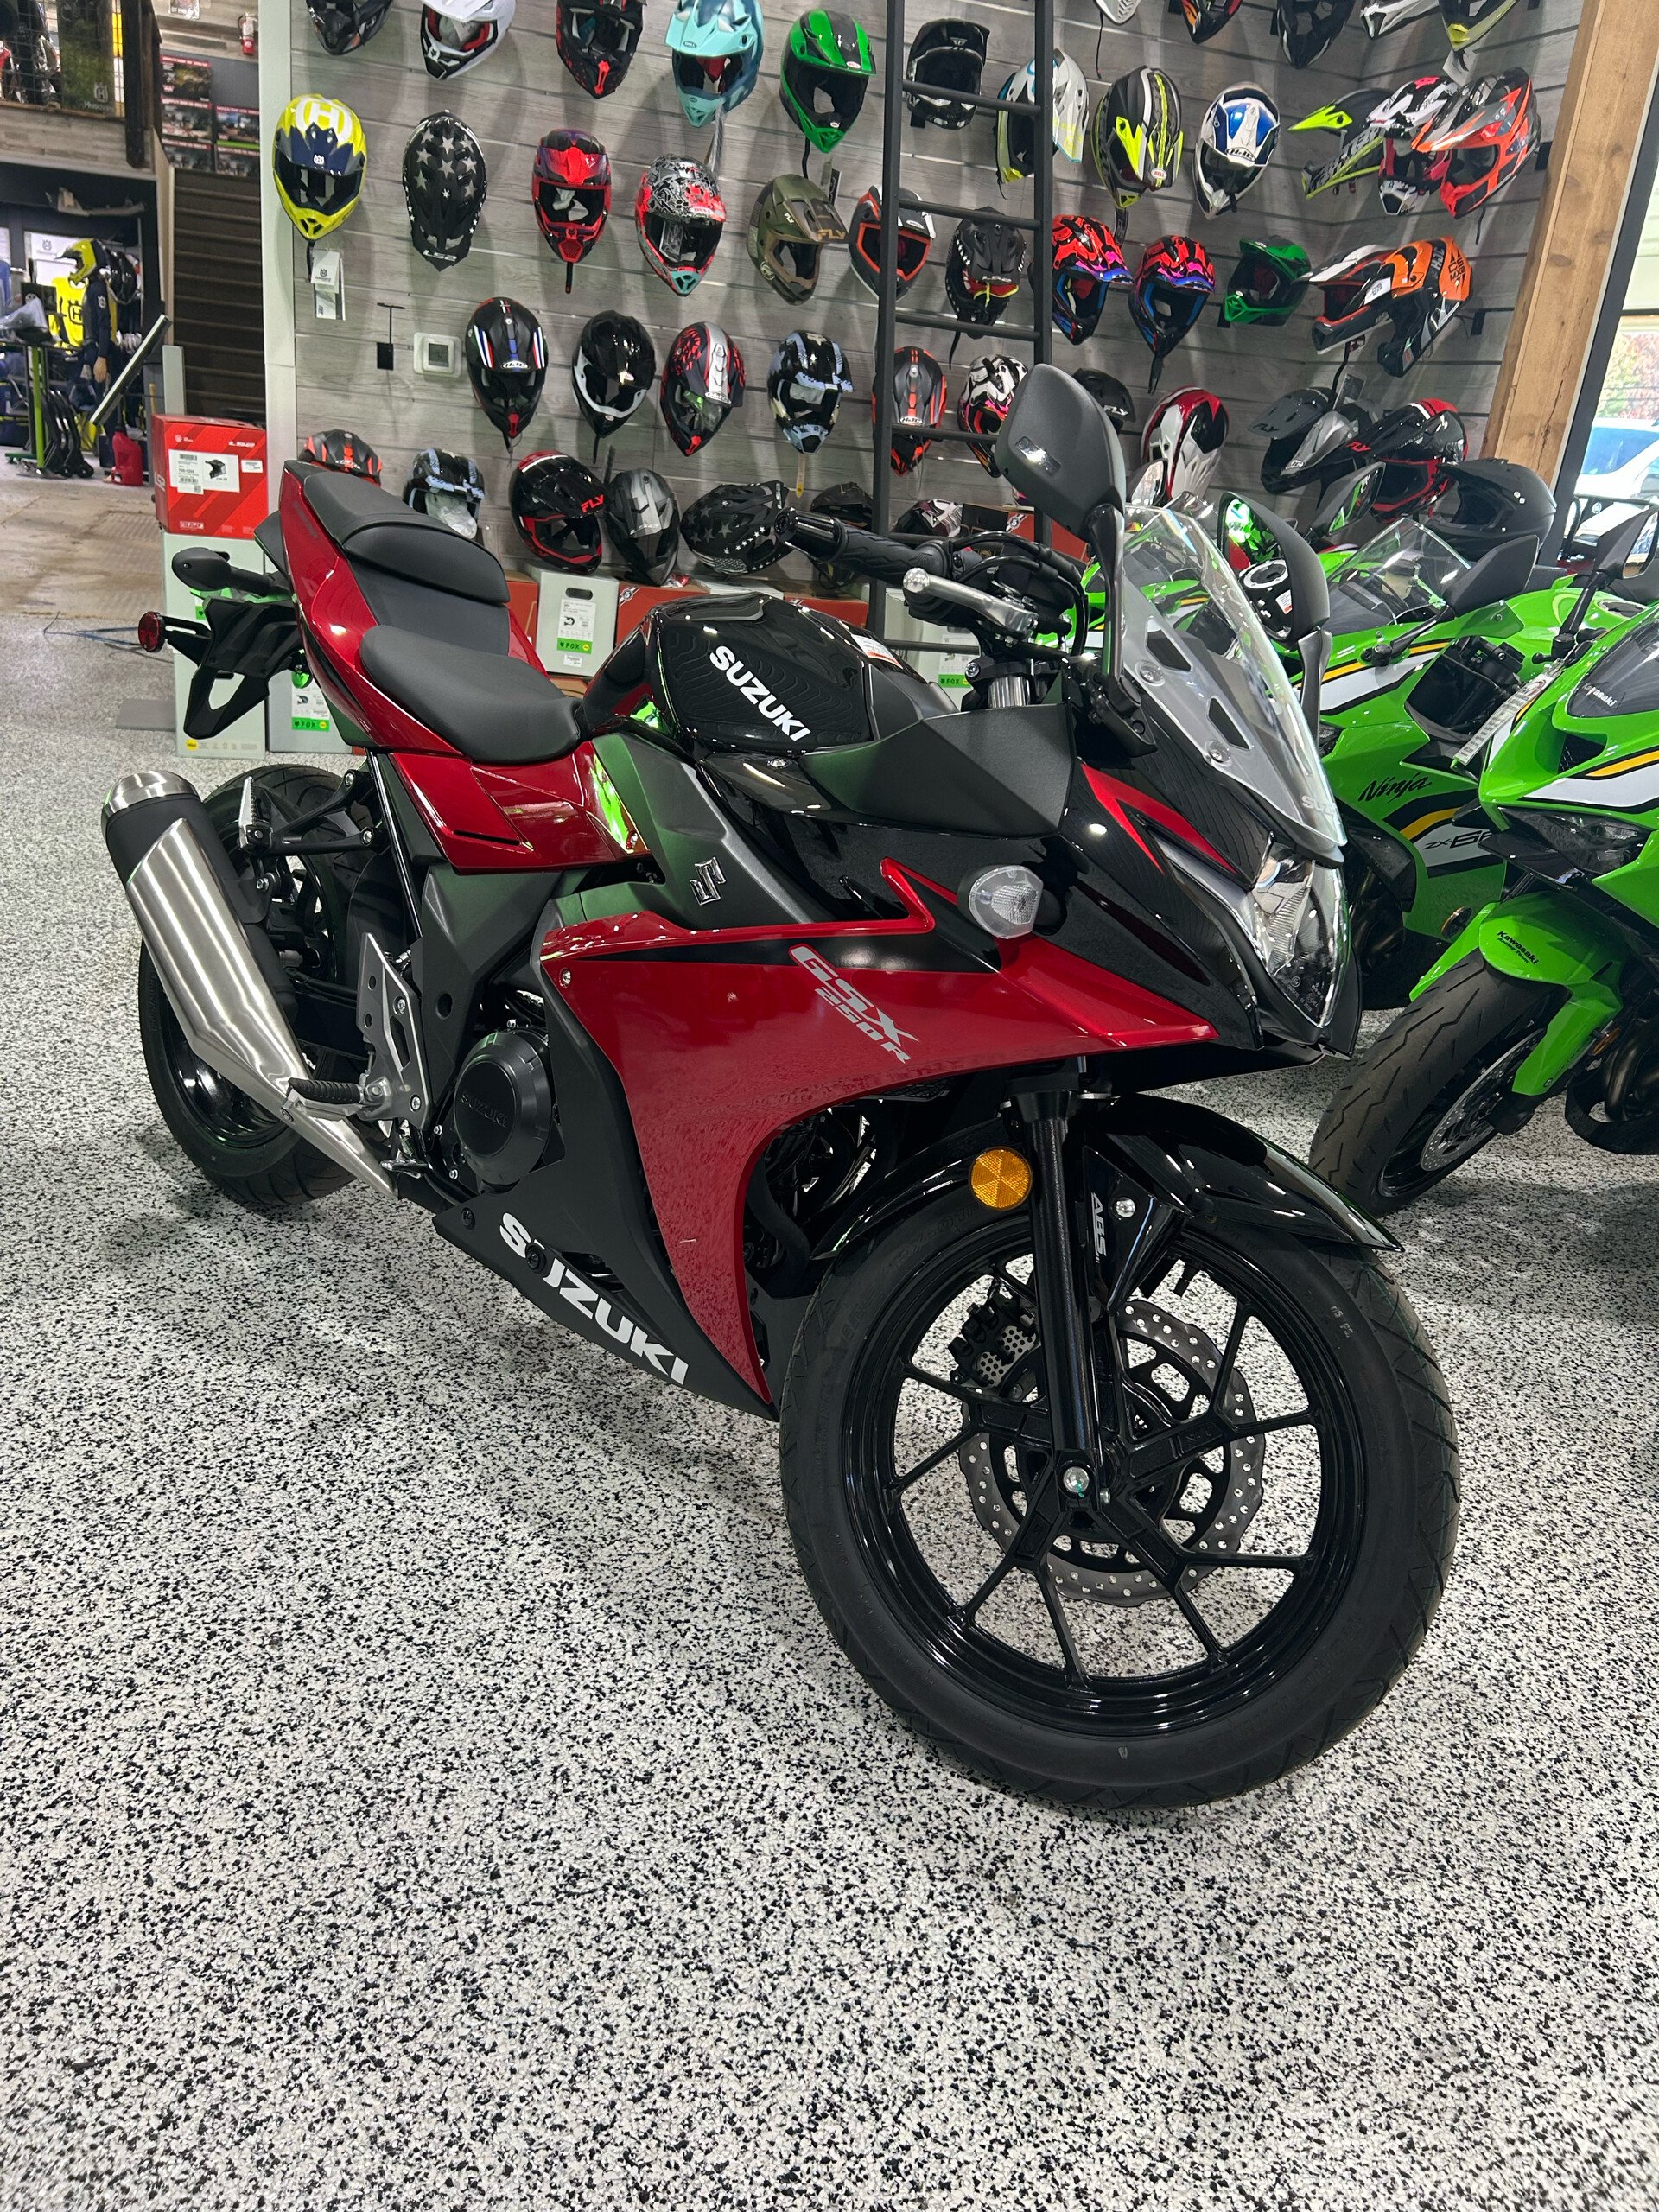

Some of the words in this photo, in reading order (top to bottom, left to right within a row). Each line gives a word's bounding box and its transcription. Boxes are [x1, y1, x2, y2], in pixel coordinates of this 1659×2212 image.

[1227, 148, 1255, 162] HJC
[784, 213, 795, 225] FLY
[817, 228, 846, 241] FLY
[423, 249, 458, 263] LS2
[1433, 248, 1446, 270] HJC
[900, 416, 923, 425] HJC
[1252, 422, 1281, 434] FLY
[1345, 441, 1372, 453] FLY
[579, 494, 605, 514] FLY
[709, 645, 811, 741] SUZUKI
[1580, 683, 1617, 708] Kawasaki
[1357, 772, 1433, 804] Ninja
[1497, 931, 1540, 965] Kawasaki
[1497, 938, 1516, 952] Racing
[1515, 950, 1529, 964] Team
[790, 945, 919, 1046] GSX
[460, 1092, 507, 1129] SUZUKI
[1090, 1192, 1108, 1259] ABS
